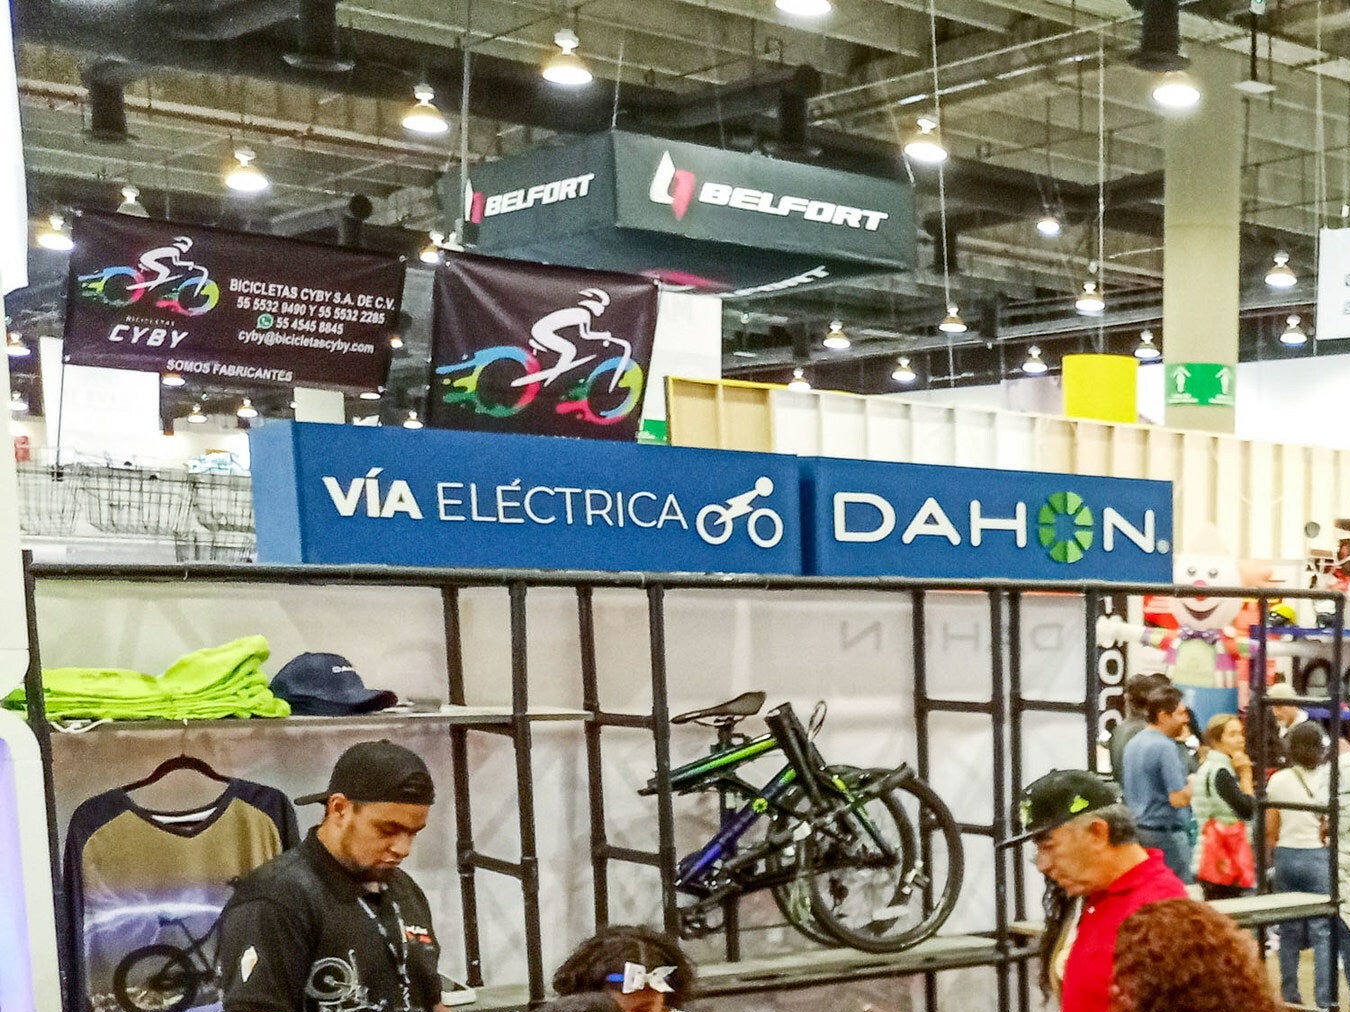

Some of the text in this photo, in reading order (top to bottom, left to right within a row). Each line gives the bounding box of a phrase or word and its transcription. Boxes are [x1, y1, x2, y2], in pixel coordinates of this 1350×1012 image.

[484, 173, 595, 218] BELFORT
[698, 182, 889, 232] BELFORT
[229, 278, 298, 299] BICICLETAS
[300, 287, 332, 303] CYBY
[357, 295, 374, 308] DE
[236, 296, 251, 309] 55
[252, 298, 279, 313] 5532
[308, 304, 319, 316] Y
[318, 306, 332, 319] 55
[333, 308, 359, 322] 5532
[108, 323, 189, 348] CYBY
[275, 316, 290, 329] 55
[291, 318, 317, 332] 4545
[238, 329, 374, 354] cyby@bicicletascyby.com
[166, 358, 294, 382] SOMOS FABRICANTES
[322, 467, 689, 531] VÍA ELÉCTRICA
